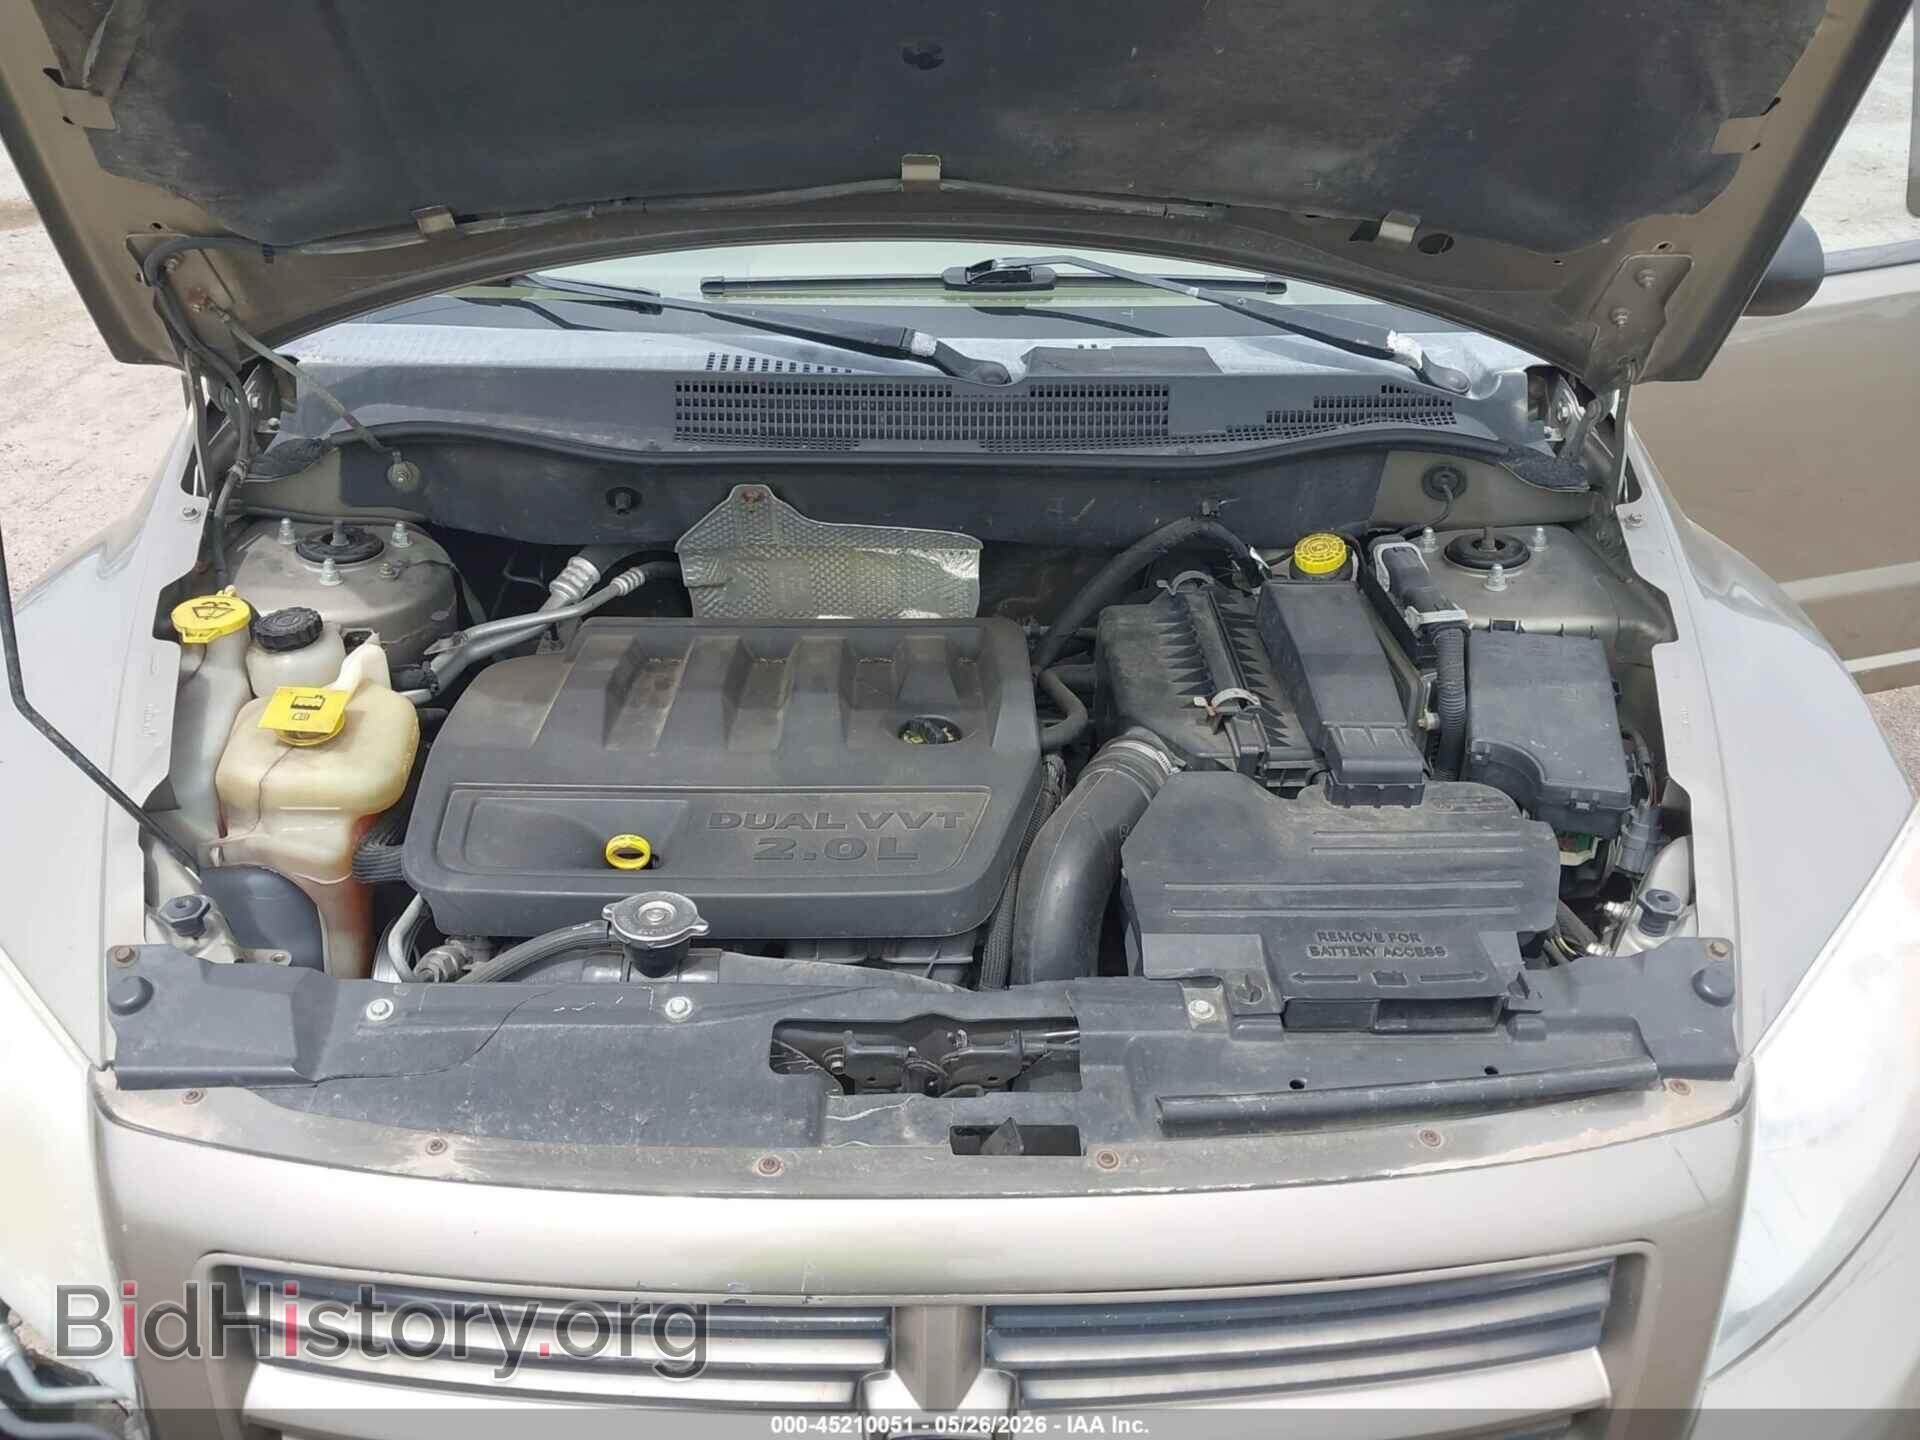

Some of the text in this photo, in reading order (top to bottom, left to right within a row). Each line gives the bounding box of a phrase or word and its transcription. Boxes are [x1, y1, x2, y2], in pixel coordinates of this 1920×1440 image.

[707, 811, 966, 830] DUAL VVT
[752, 837, 918, 861] 2.0L
[1317, 931, 1422, 943] REMOVE FOR
[1308, 945, 1447, 958] BATTERY ACCESS
